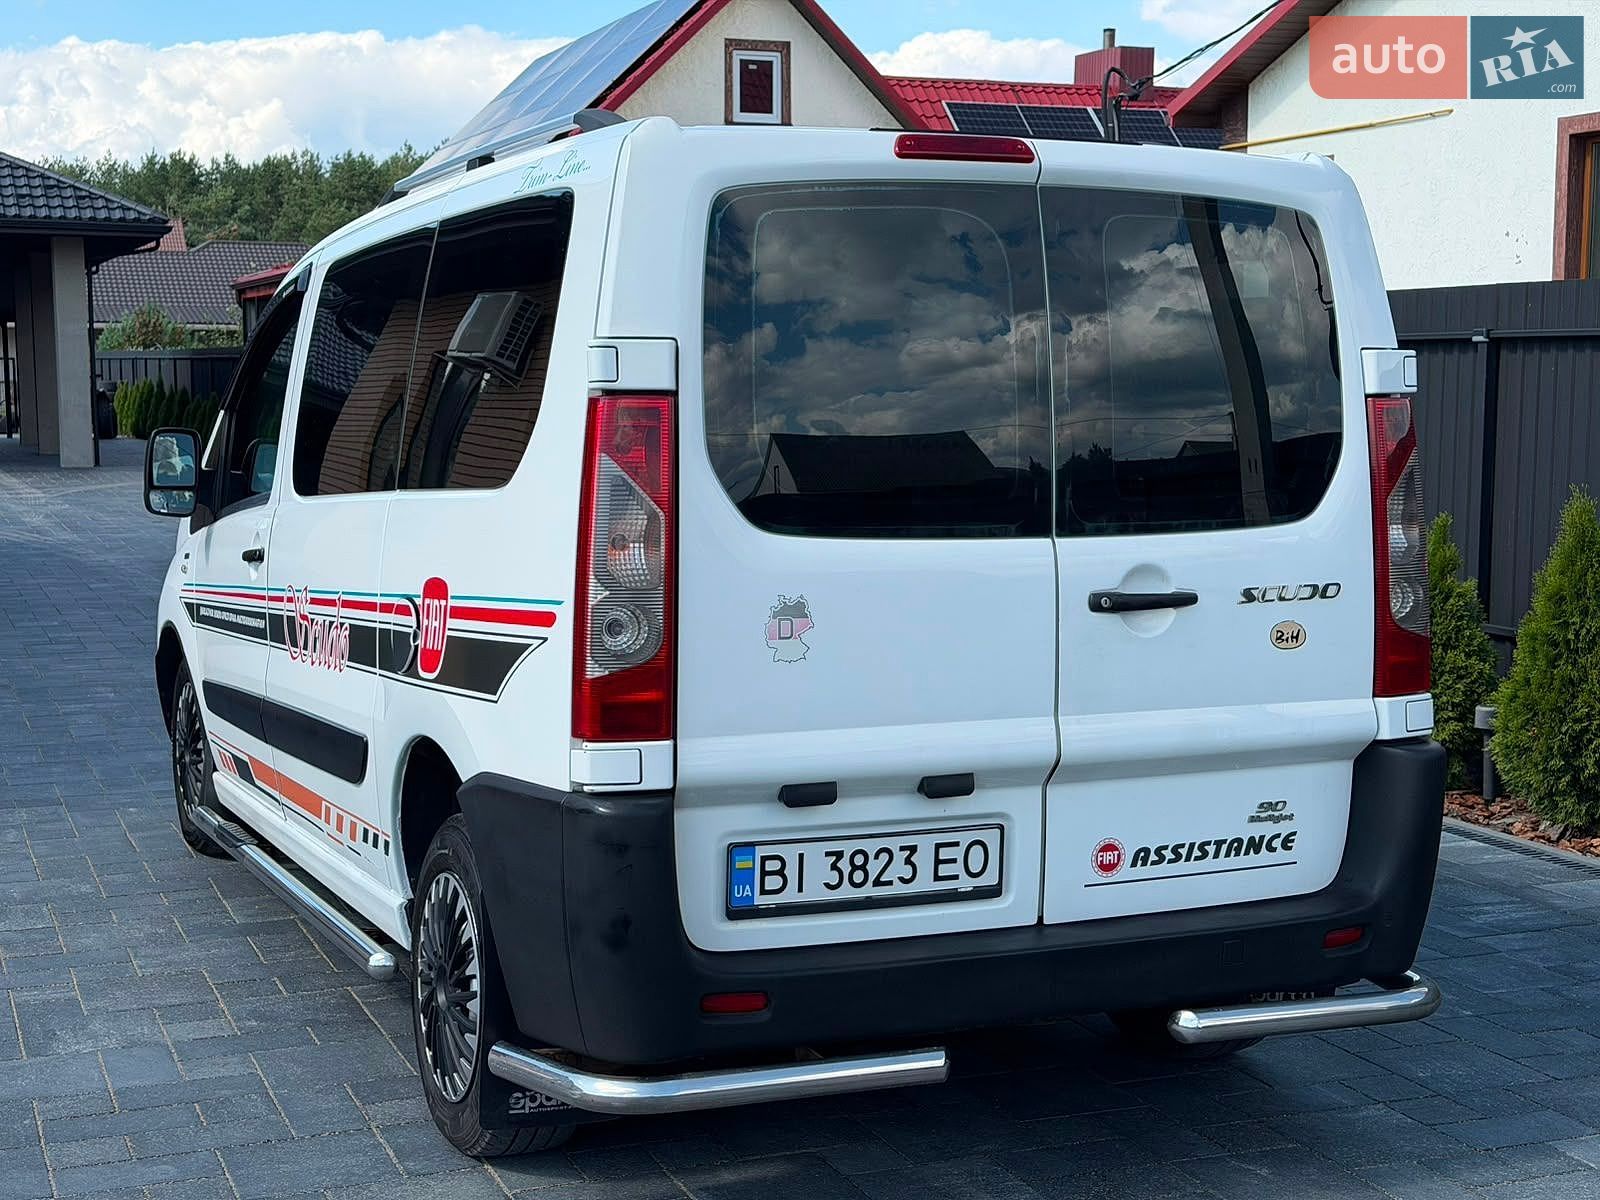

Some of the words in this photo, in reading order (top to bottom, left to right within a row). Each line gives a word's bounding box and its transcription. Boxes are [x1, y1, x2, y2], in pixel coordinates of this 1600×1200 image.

[1237, 582, 1342, 605] SCUDO
[423, 599, 447, 651] FIAT
[777, 617, 794, 640] D
[1255, 800, 1287, 813] 90
[1097, 851, 1120, 866] FIAT
[1129, 831, 1298, 868] ASSISTANCE
[758, 852, 805, 896] BI
[823, 844, 919, 891] 3823
[933, 839, 990, 882] EO
[734, 885, 752, 898] UA
